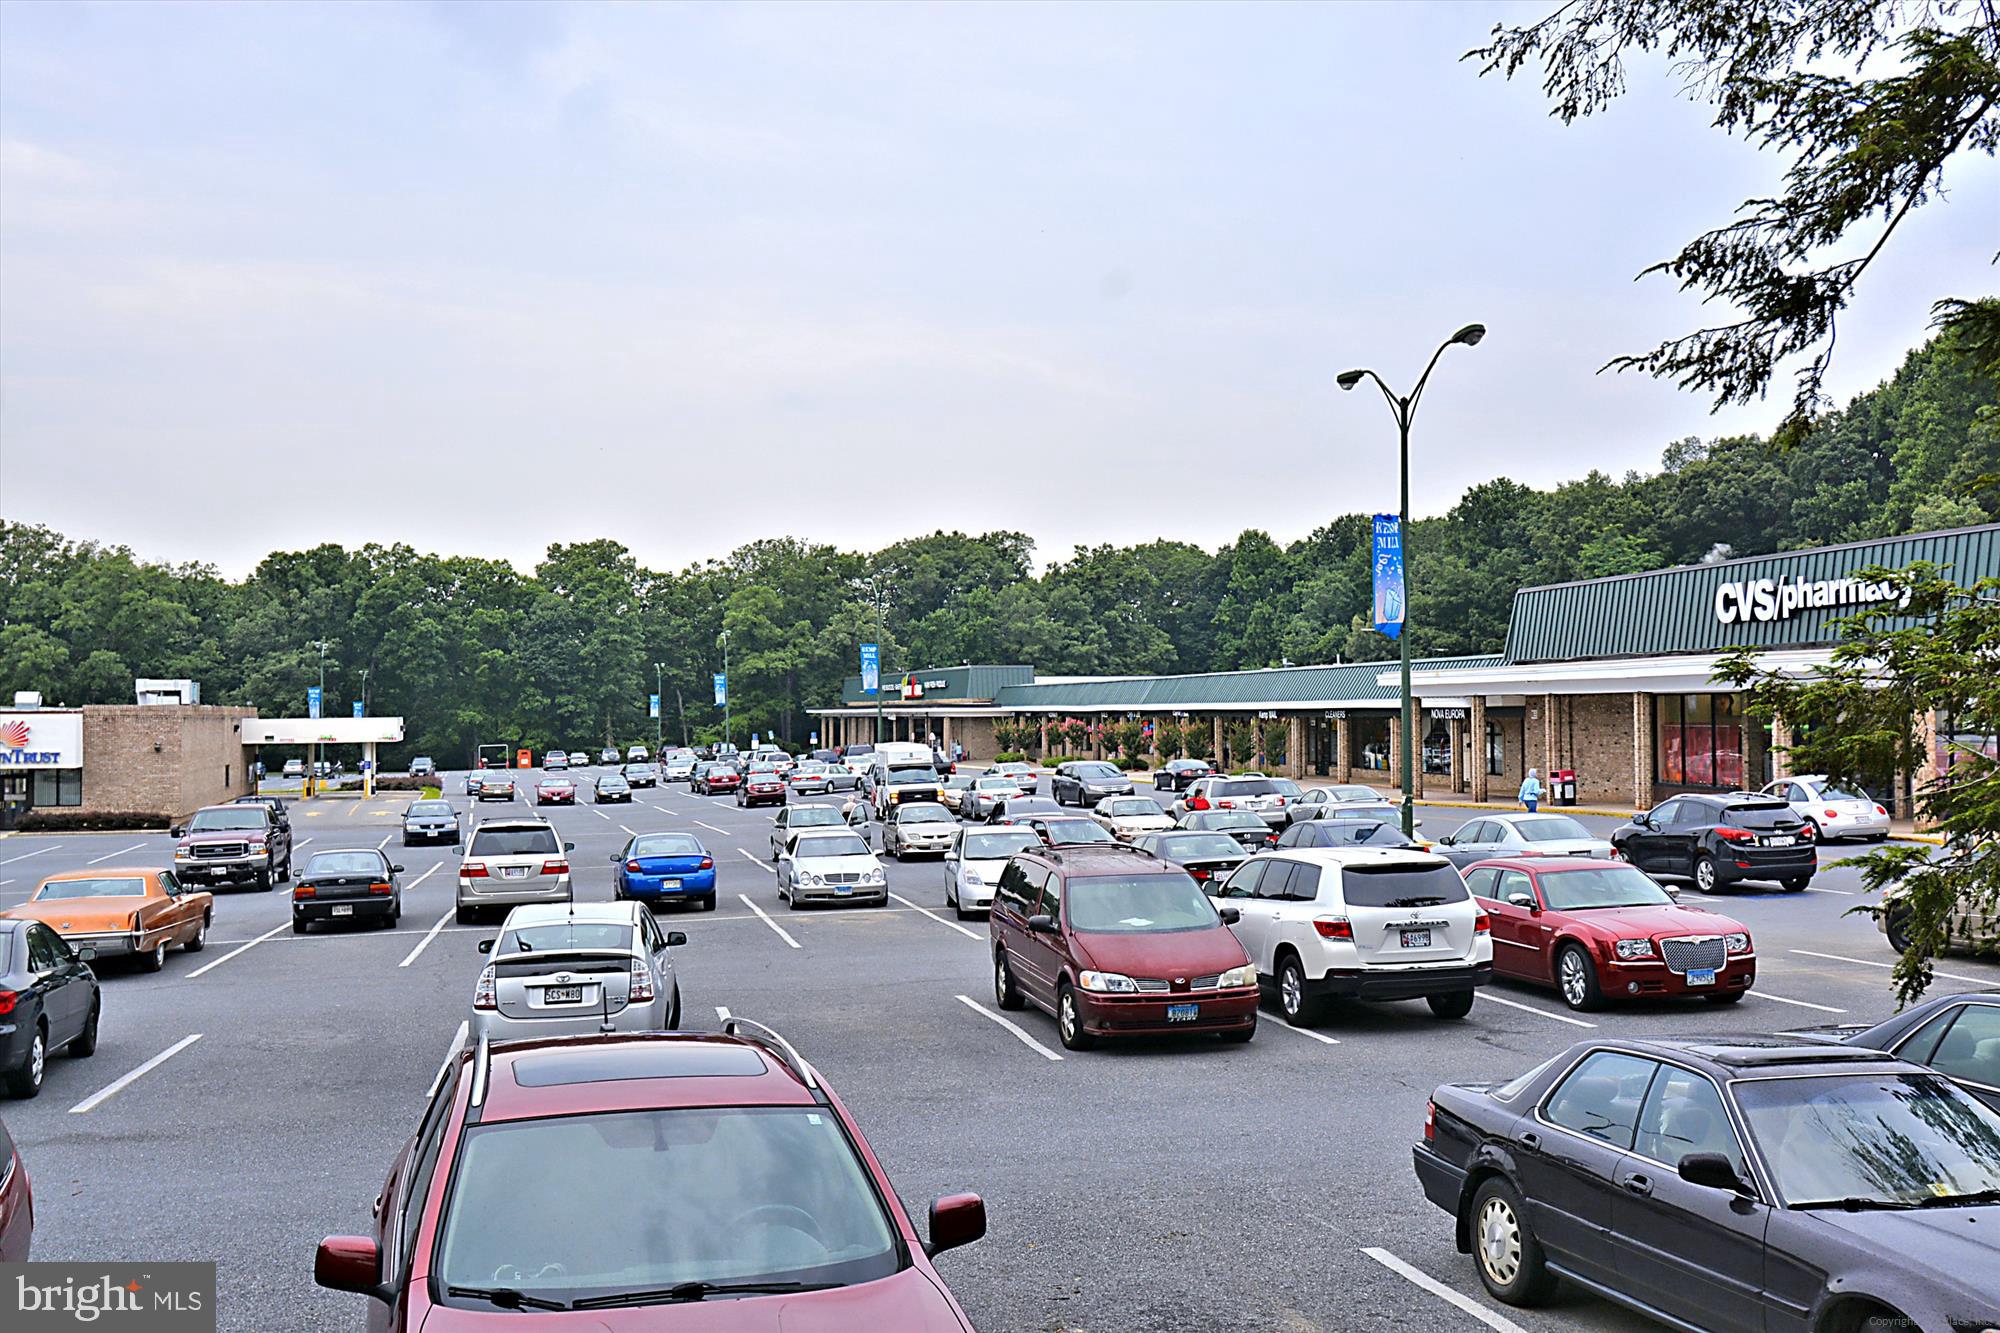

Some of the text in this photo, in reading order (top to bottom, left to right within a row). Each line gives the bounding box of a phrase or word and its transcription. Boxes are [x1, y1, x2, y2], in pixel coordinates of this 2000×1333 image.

[1325, 710, 1346, 719] CLEANERS
[1431, 709, 1465, 719] NOVA EUROPA
